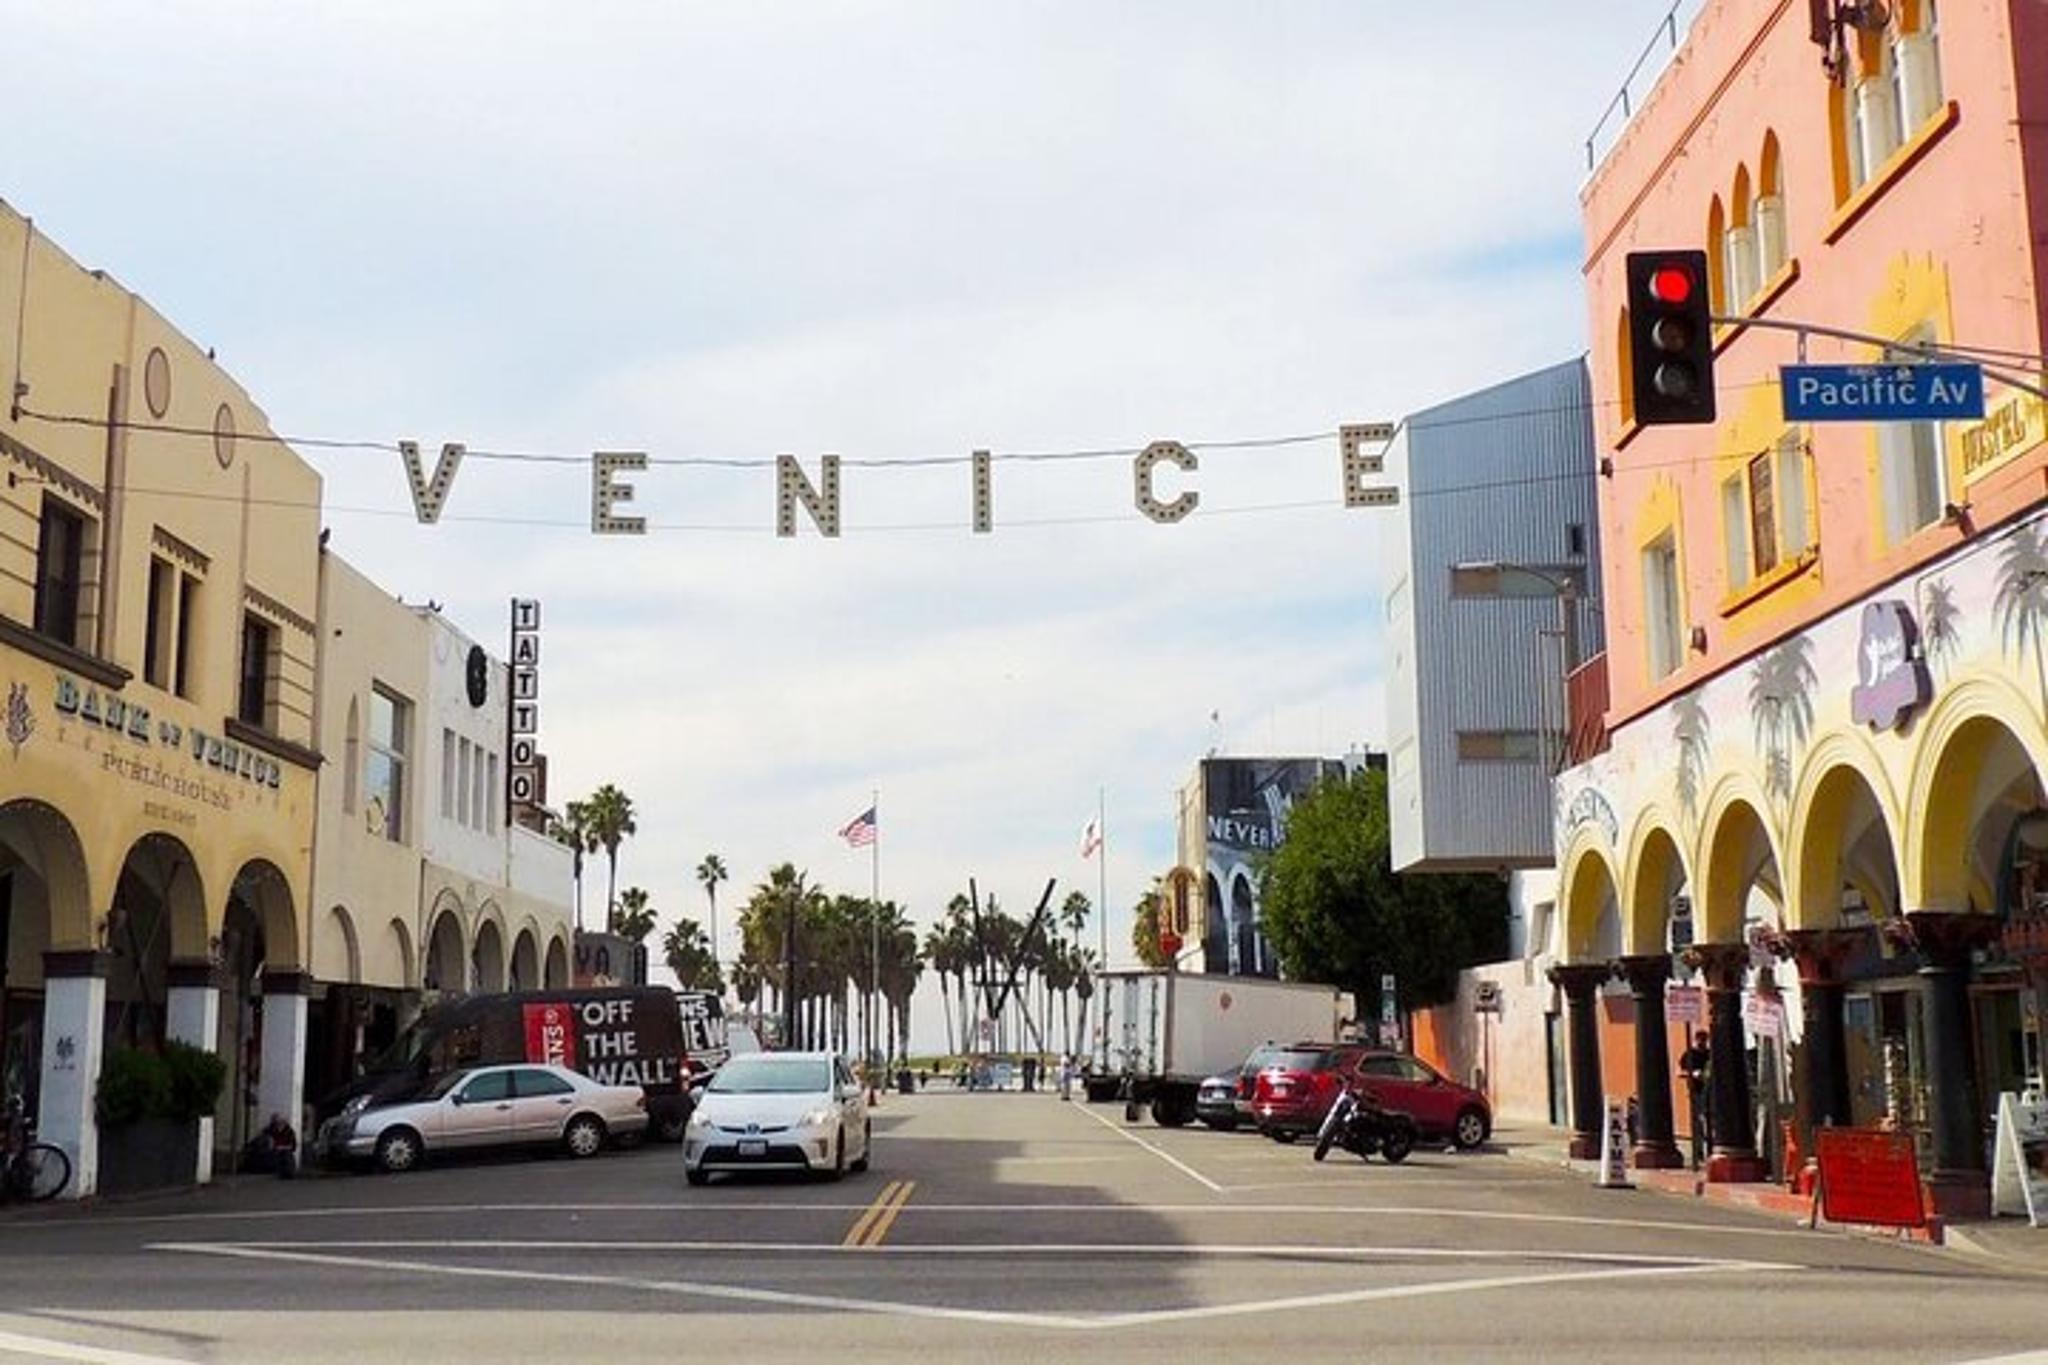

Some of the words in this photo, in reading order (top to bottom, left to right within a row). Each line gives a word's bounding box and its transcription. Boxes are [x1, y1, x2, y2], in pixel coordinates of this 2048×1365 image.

[1799, 375, 1917, 406] Pacific
[1928, 375, 1968, 405] Av
[399, 423, 1400, 537] VENICE
[54, 674, 151, 743] BANK
[188, 726, 281, 790] VENICE
[512, 602, 535, 799] TATTOO
[584, 1030, 638, 1058] THE
